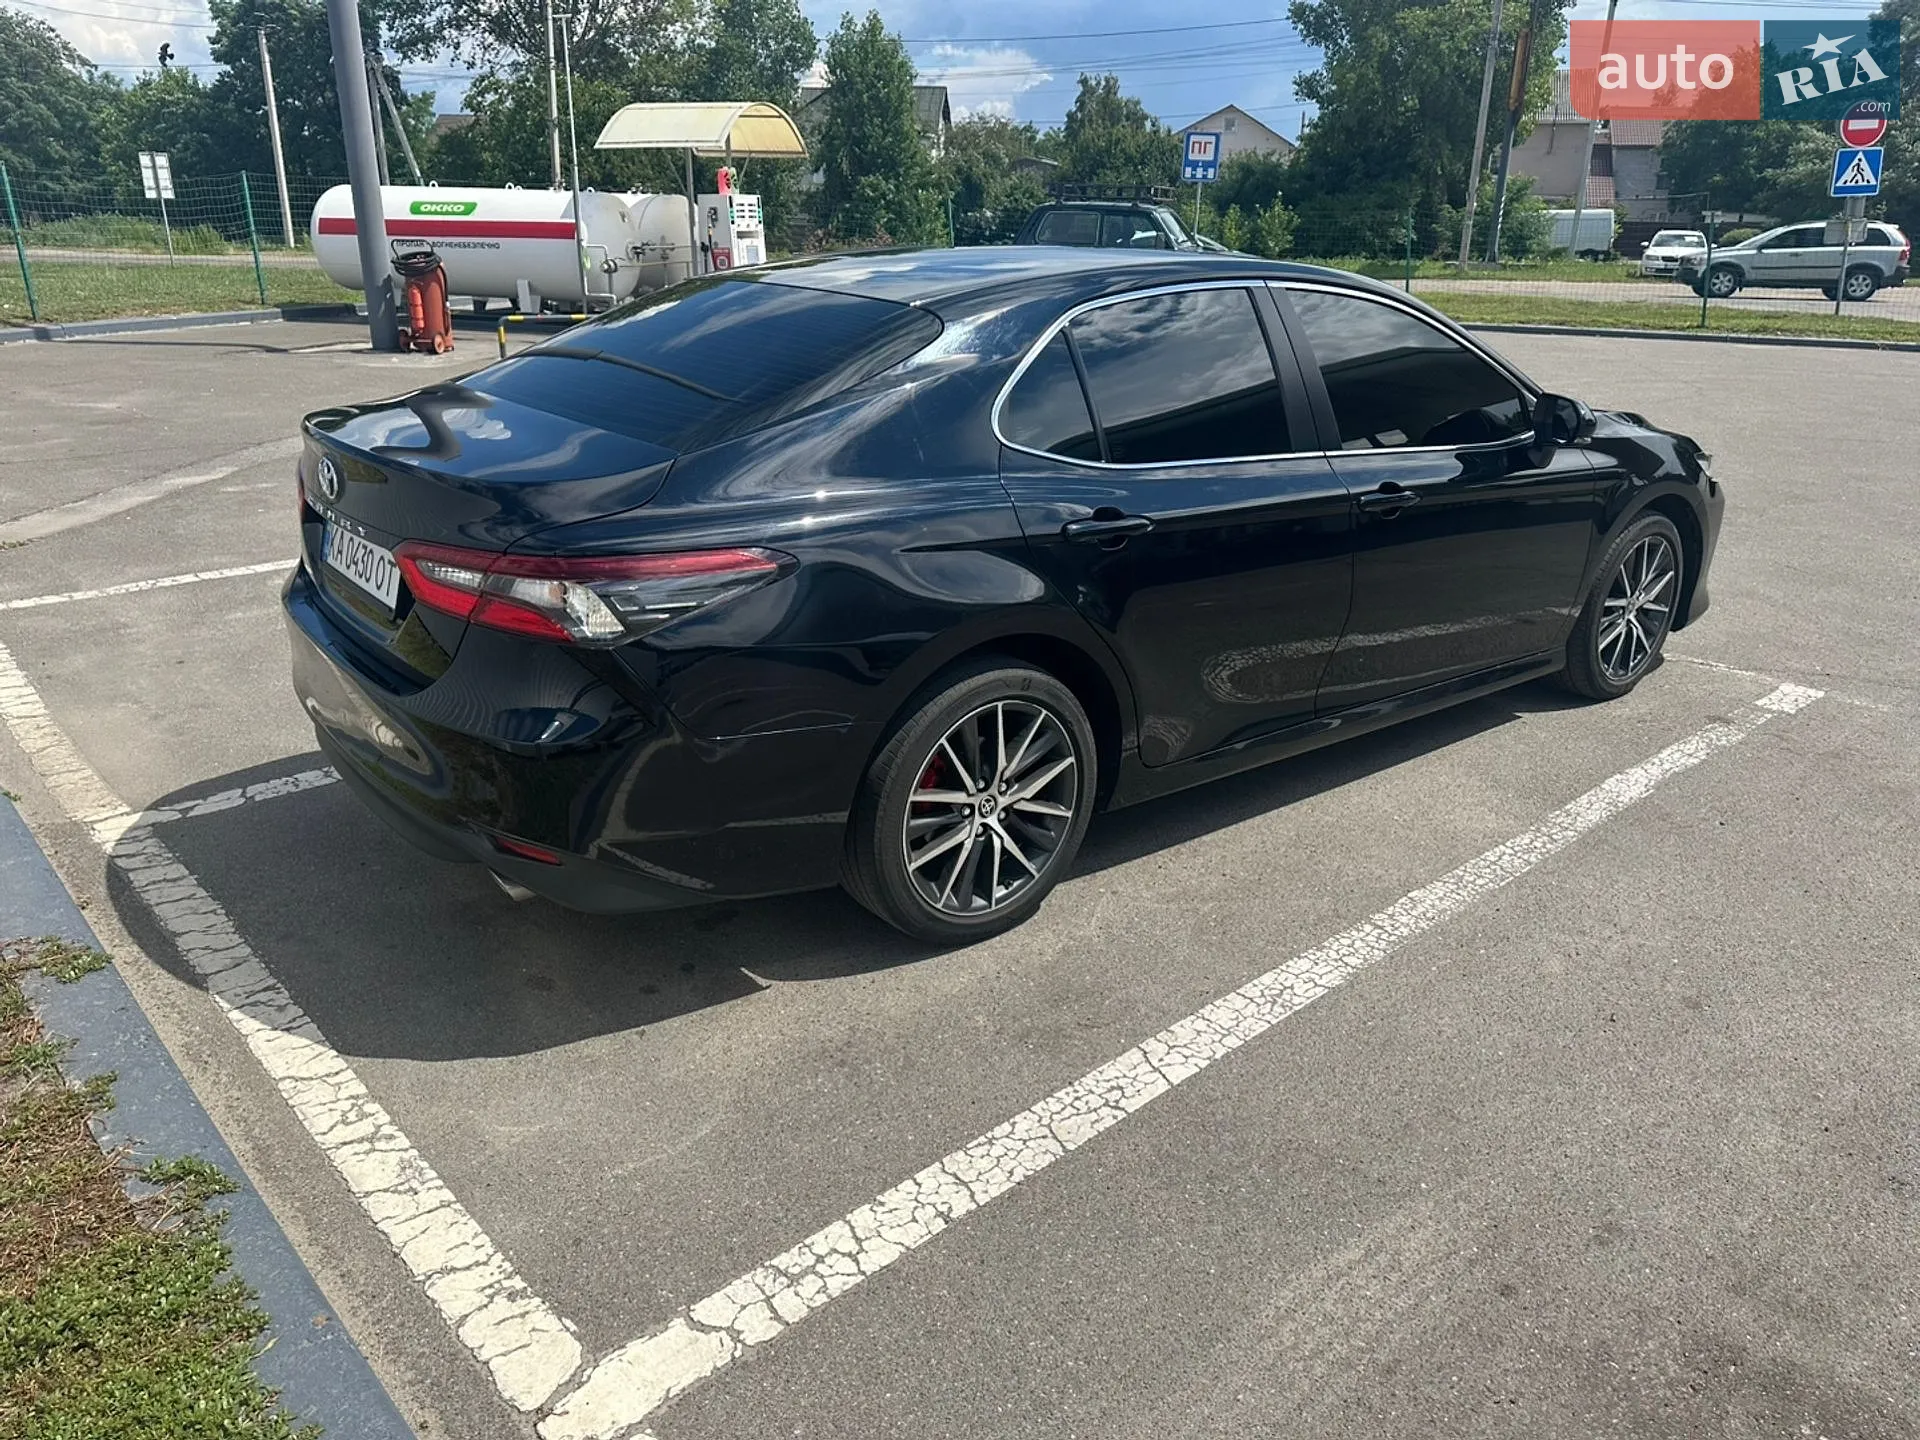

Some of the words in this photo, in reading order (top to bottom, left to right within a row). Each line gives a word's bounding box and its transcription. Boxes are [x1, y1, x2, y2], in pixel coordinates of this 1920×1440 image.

[1191, 141, 1213, 154] ПГ
[420, 204, 465, 212] OKKO
[330, 528, 345, 565] KA
[345, 536, 374, 584] 0430
[375, 556, 397, 597] OT
